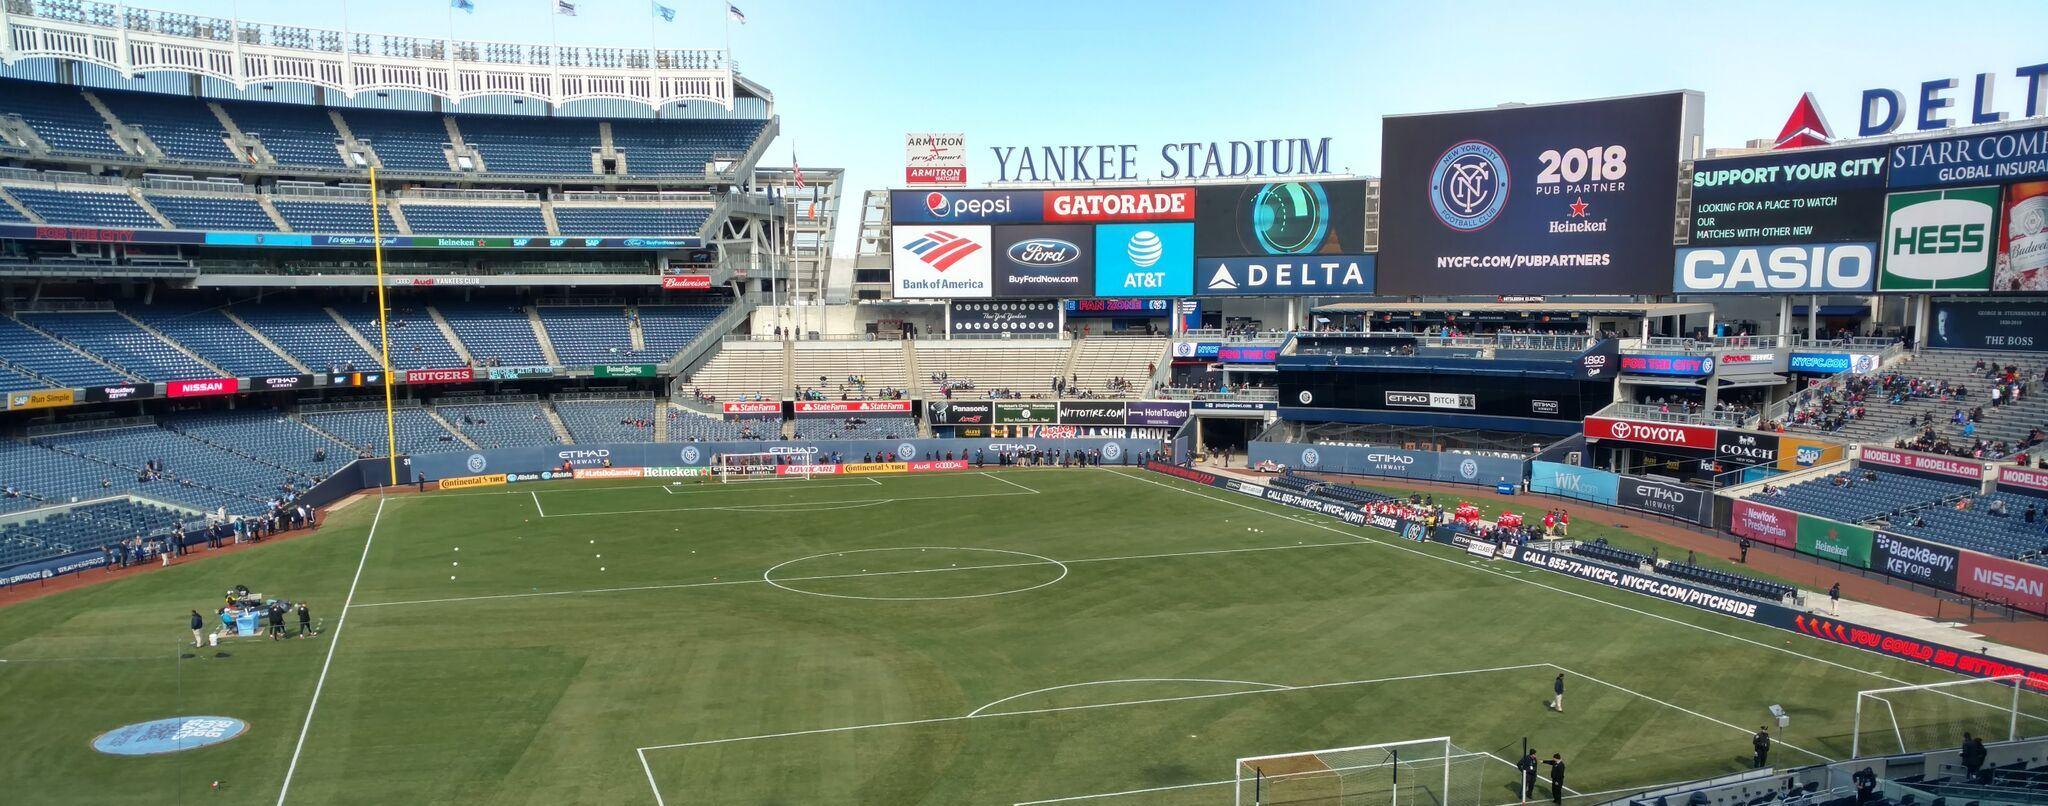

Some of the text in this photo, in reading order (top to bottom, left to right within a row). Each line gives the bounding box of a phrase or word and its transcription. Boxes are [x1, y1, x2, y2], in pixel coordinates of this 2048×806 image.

[908, 137, 963, 146] ARMITRON
[1443, 144, 1499, 165] NEW YORK CITY
[1894, 137, 1972, 168] STARR
[990, 137, 1332, 182] YANKEE STADIUM
[1537, 145, 1627, 184] 2018
[911, 169, 960, 177] ARMITRON
[1693, 157, 1885, 188] SUPPORT YOUR CITY
[1939, 165, 1992, 181] GLOBAL
[1536, 182, 1625, 195] PUB PARTNER
[954, 195, 1010, 217] pepsi
[1053, 193, 1186, 215] GATORADE
[1698, 197, 1838, 213] LOOKING FOR A PLACE TO WATCH
[1441, 207, 1497, 227] FOOTBALL CLUB
[1697, 217, 1715, 227] OUR
[1549, 220, 1607, 233] Heineken
[1696, 226, 1814, 239] MATCHES WITH OTHER NEW
[36, 227, 134, 241] FOR THE CITY
[1894, 223, 1985, 255] HESS
[1022, 243, 1065, 263] Ford
[1437, 253, 1610, 268] NYCFC.COM/PUBPARTNERS
[1248, 262, 1364, 286] DELTA
[1683, 245, 1872, 290] CASIO
[664, 276, 710, 288] Budweiser
[903, 279, 984, 289] Bank of America
[1009, 275, 1079, 285] BuyFordNow.com
[1124, 272, 1165, 288] AT&T
[1080, 300, 1104, 310] FAN
[1107, 299, 1142, 310] ZONE
[1985, 335, 2033, 346] THE BOSS
[1584, 355, 1605, 365] 1893
[1673, 358, 1701, 372] CITY
[1791, 356, 1848, 368] NYCFC.COM
[409, 371, 470, 381] RUTGERS
[182, 383, 223, 393] NISSAN
[32, 395, 45, 403] Run
[47, 394, 70, 403] Simple
[1388, 394, 1455, 405] ETIHAD PITCH
[1060, 407, 1125, 419] NITTOTIRE.COM
[1145, 408, 1188, 419] HotelTonight
[1632, 426, 1686, 443] TOYOTA
[559, 449, 609, 458] ETIHAD
[989, 443, 1037, 452] ETIHAD
[1720, 444, 1773, 460] COACH
[1368, 453, 1414, 465] ETIHAD
[1797, 447, 1819, 466] SAP
[1864, 450, 1978, 476] MODELL'S MODELLS.com
[643, 467, 698, 477] Heineken
[785, 465, 836, 473] ADVOCARE
[845, 463, 884, 472] Continental
[1375, 463, 1406, 472] AIRWAYS
[1700, 460, 1724, 473] FedEx
[441, 477, 482, 488] Continental
[1267, 490, 1281, 500] CALL
[1636, 485, 1684, 504] ETIHAD
[1644, 502, 1675, 512] AIRWAYS
[1748, 519, 1786, 537] Presbyterian
[1815, 540, 1848, 556] Heineken
[1889, 540, 1953, 571] BlackBerry
[1523, 550, 1757, 618] CALL 855-77-NYCFC, NYCFC.COM/PITCHSIDE
[1974, 567, 2044, 598] NISSAN
[1850, 628, 1879, 647] YOU
[1881, 638, 1933, 660] COULD
